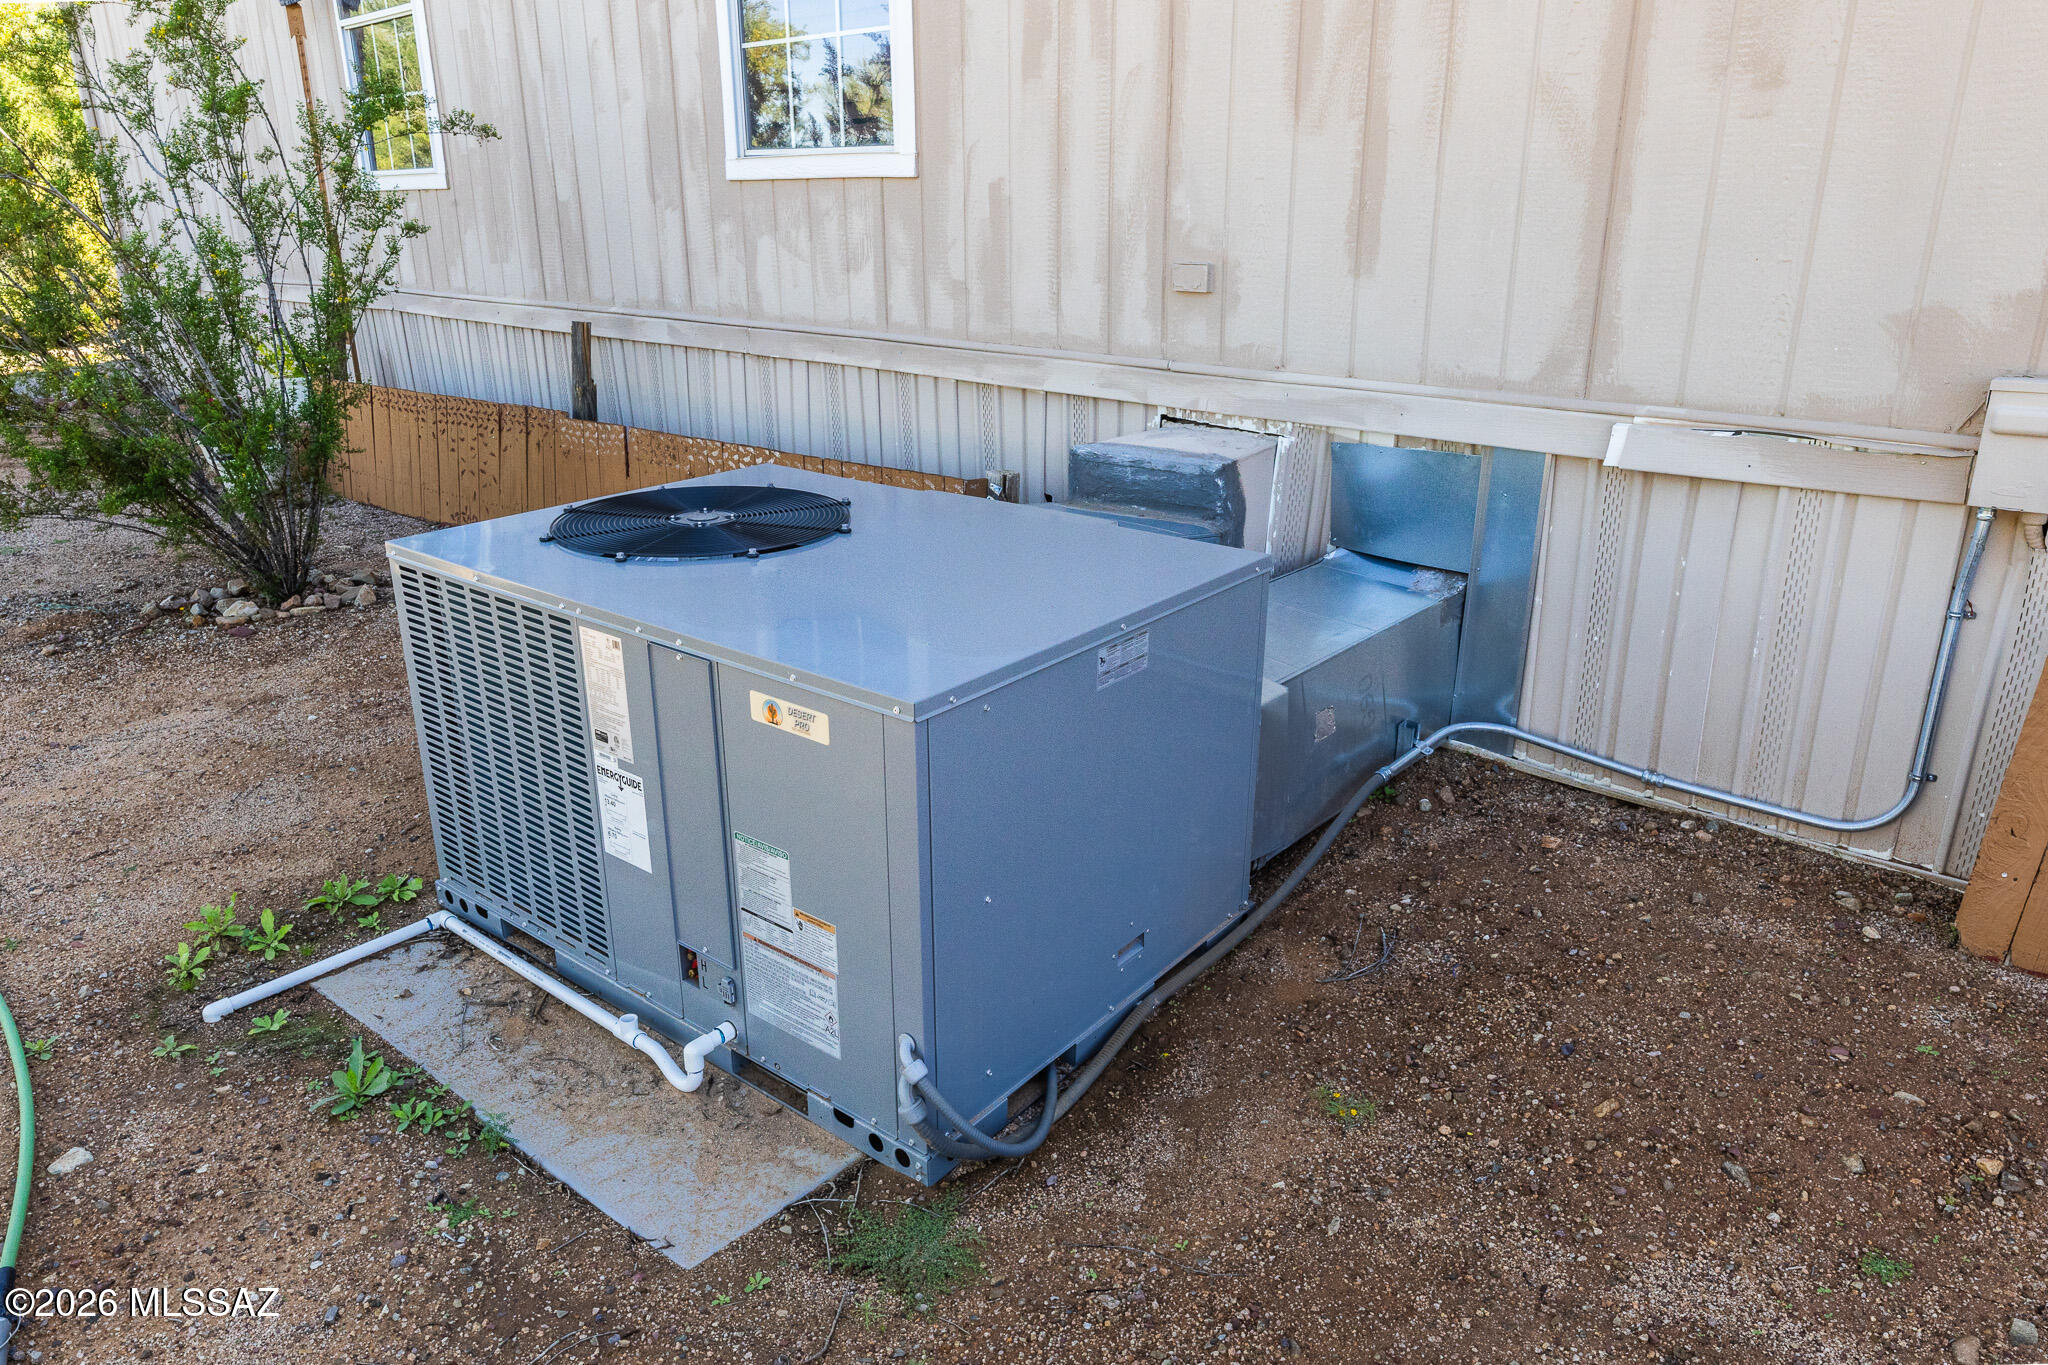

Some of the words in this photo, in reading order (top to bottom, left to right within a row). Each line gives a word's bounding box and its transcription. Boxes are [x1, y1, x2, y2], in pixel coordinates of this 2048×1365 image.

[787, 707, 816, 723] DESERT
[794, 720, 810, 732] PRO
[596, 765, 642, 791] ENERGYGUIDE
[701, 959, 707, 972] H
[702, 976, 709, 990] L
